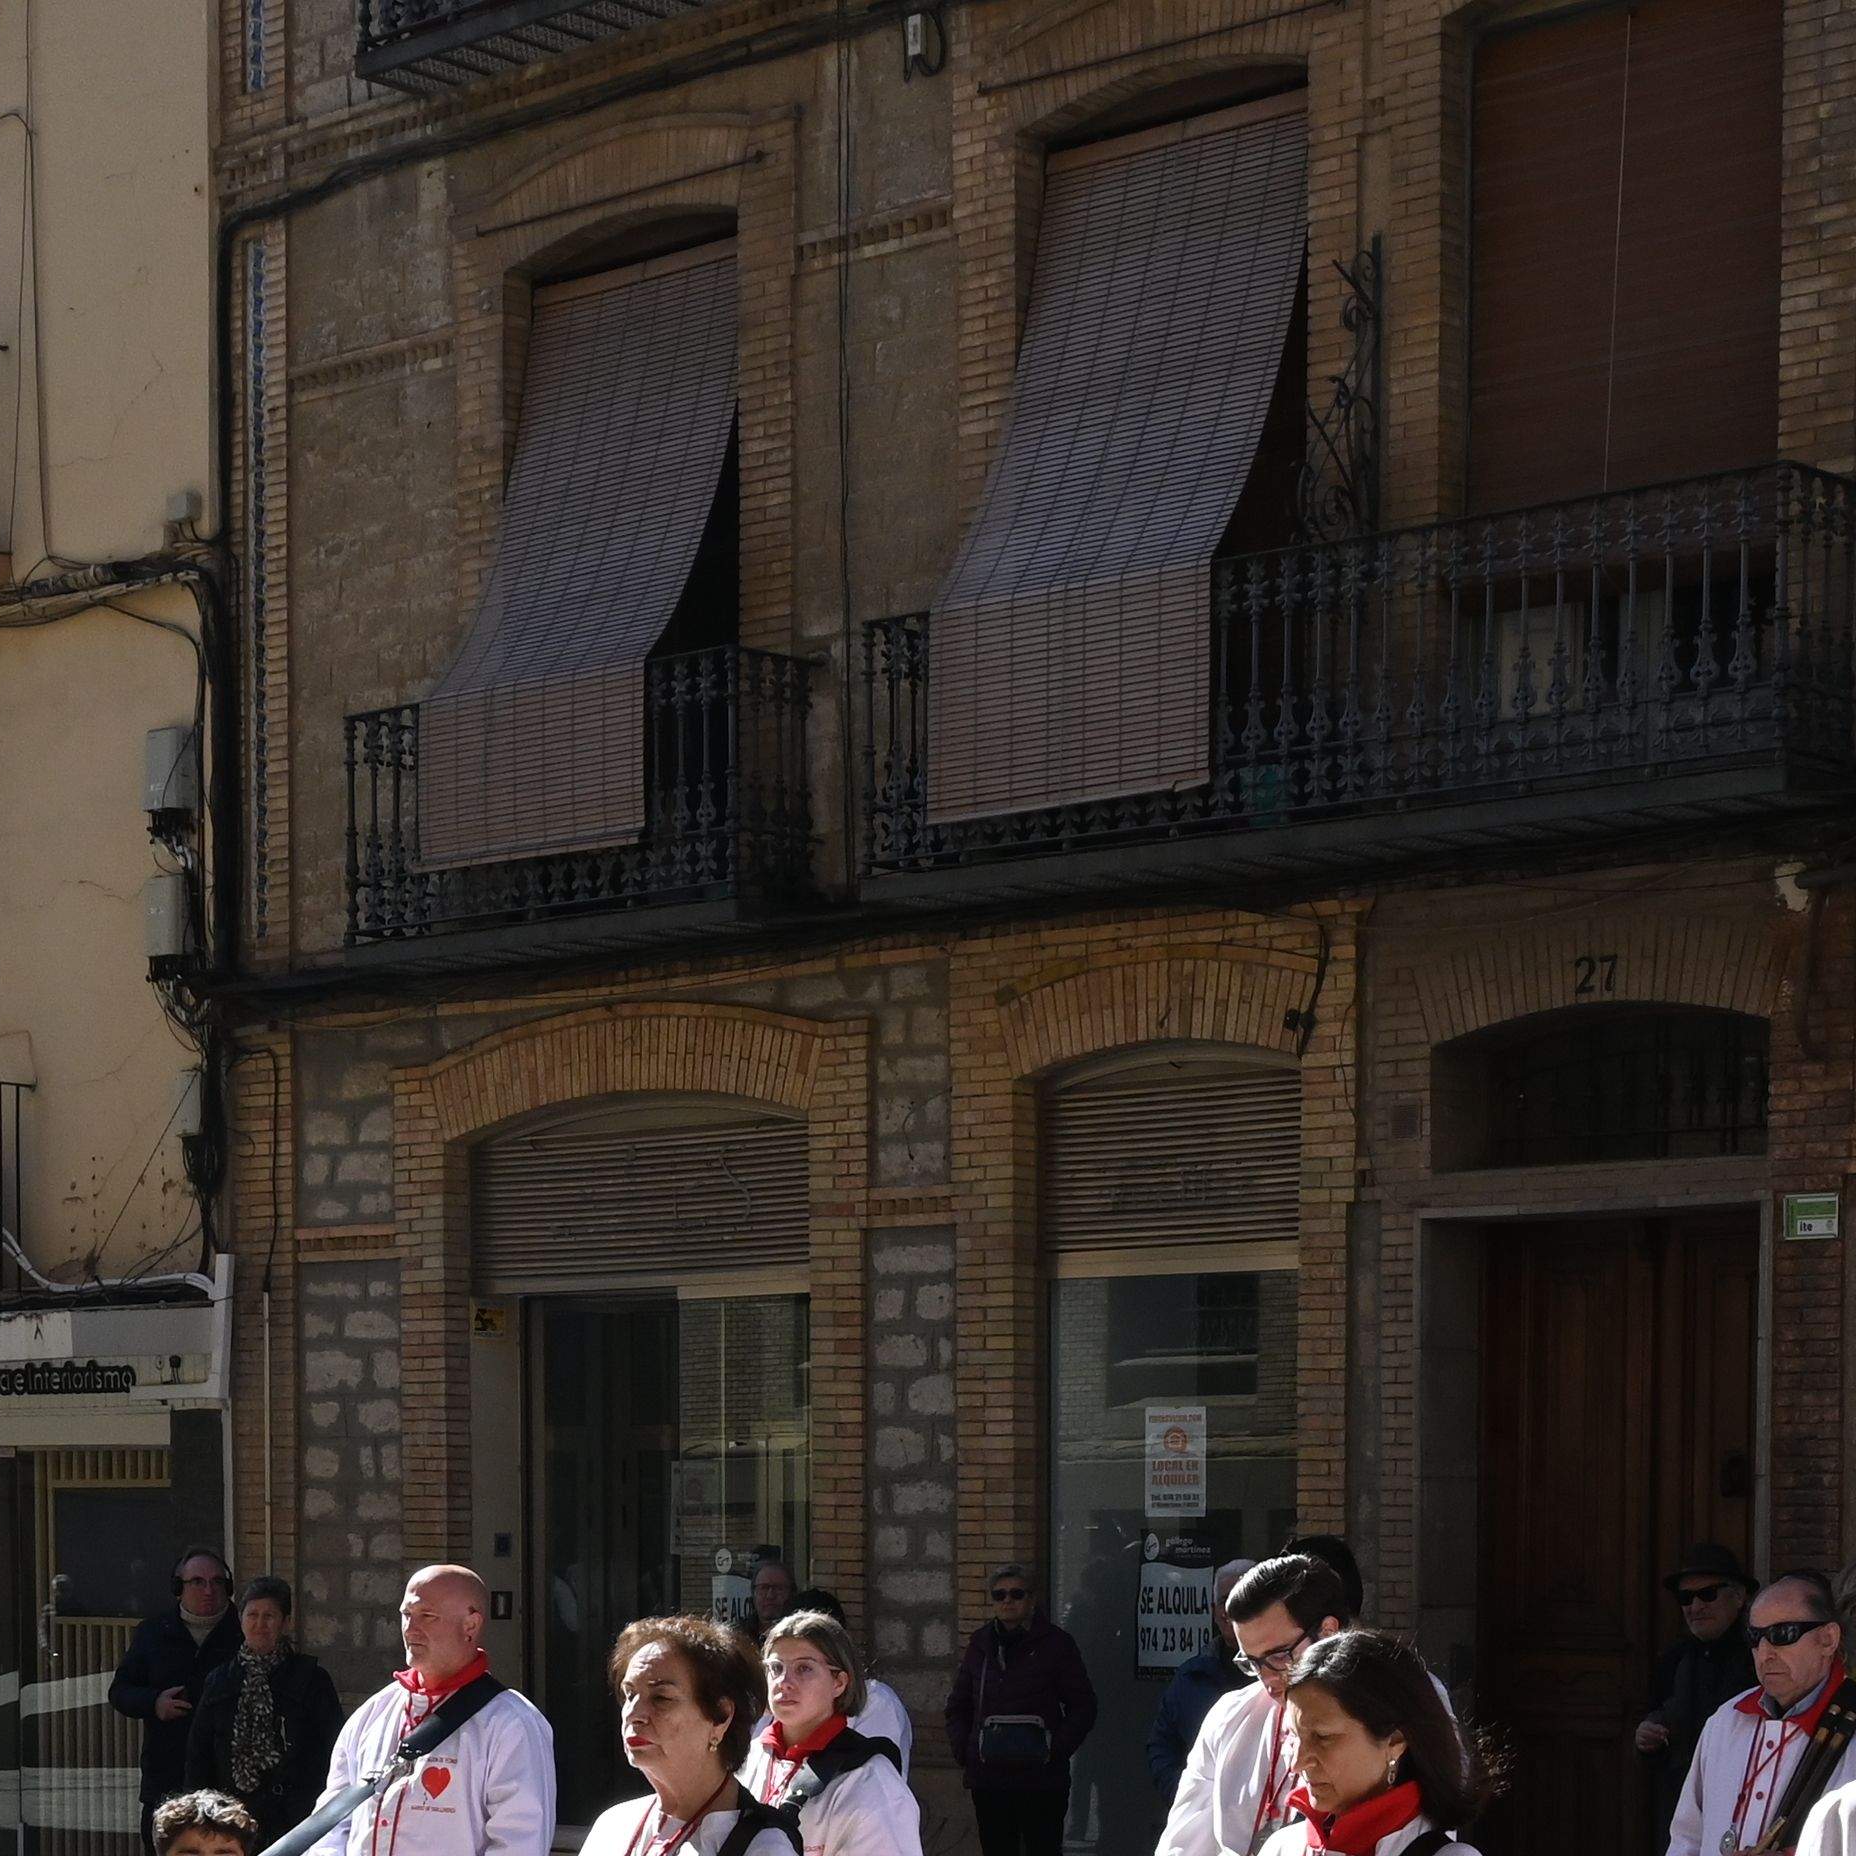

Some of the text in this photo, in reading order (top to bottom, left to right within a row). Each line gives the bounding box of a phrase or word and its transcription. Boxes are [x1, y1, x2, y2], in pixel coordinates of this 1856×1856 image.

[1574, 953, 1618, 993] 27
[11, 1369, 25, 1394] e
[26, 1360, 136, 1393] Interiorismo
[1152, 1460, 1184, 1472] LOCAL
[1152, 1474, 1200, 1486] ALQUILER
[714, 1597, 728, 1622] SE
[1140, 1586, 1210, 1615] SE ALQUILA
[1140, 1626, 1158, 1651] 974
[1162, 1627, 1176, 1652] 23
[1179, 1627, 1193, 1652] 84
